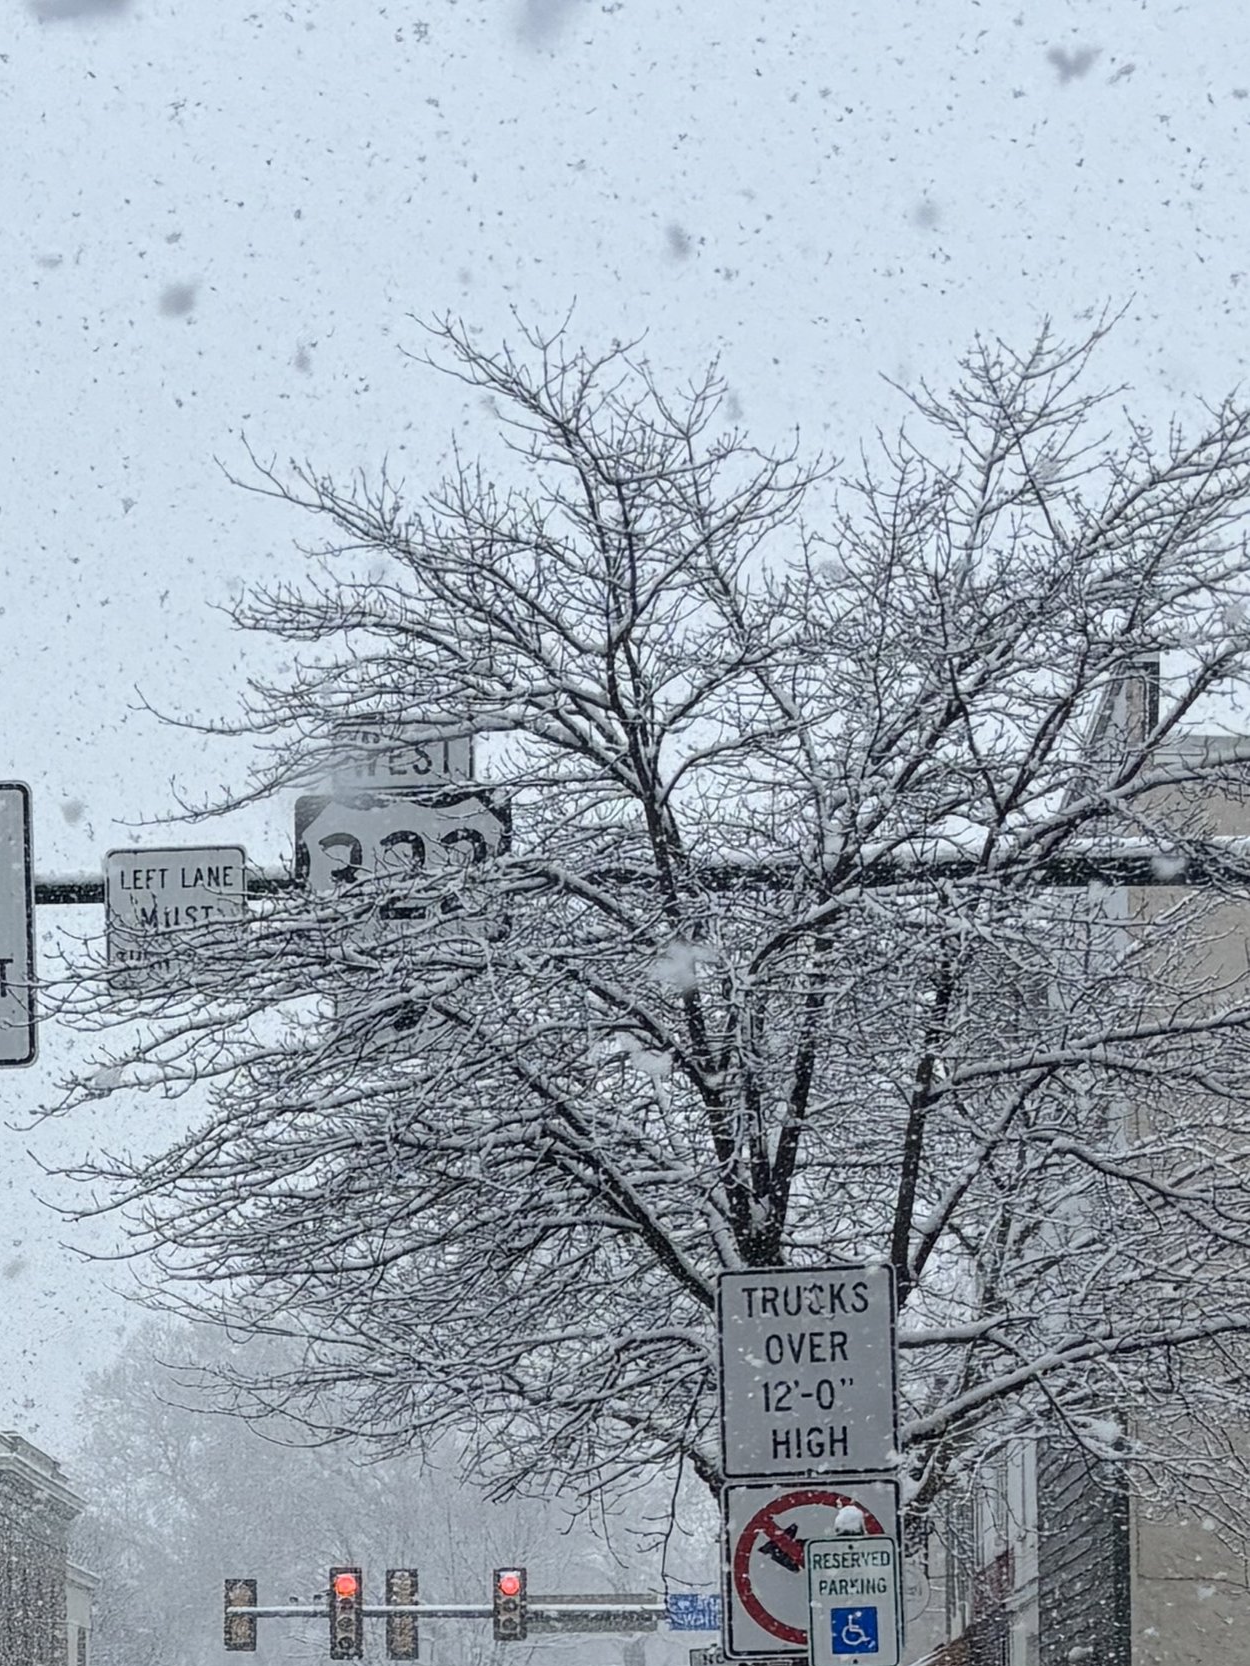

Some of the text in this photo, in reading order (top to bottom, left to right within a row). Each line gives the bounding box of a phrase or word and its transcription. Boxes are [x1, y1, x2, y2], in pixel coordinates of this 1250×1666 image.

[120, 866, 234, 890] LEFT LANE
[742, 1281, 869, 1318] TRUCKS
[765, 1331, 849, 1365] OVER
[772, 1426, 849, 1459] HIGH
[813, 1551, 891, 1570] RESERVED
[819, 1578, 887, 1596] PARKING
